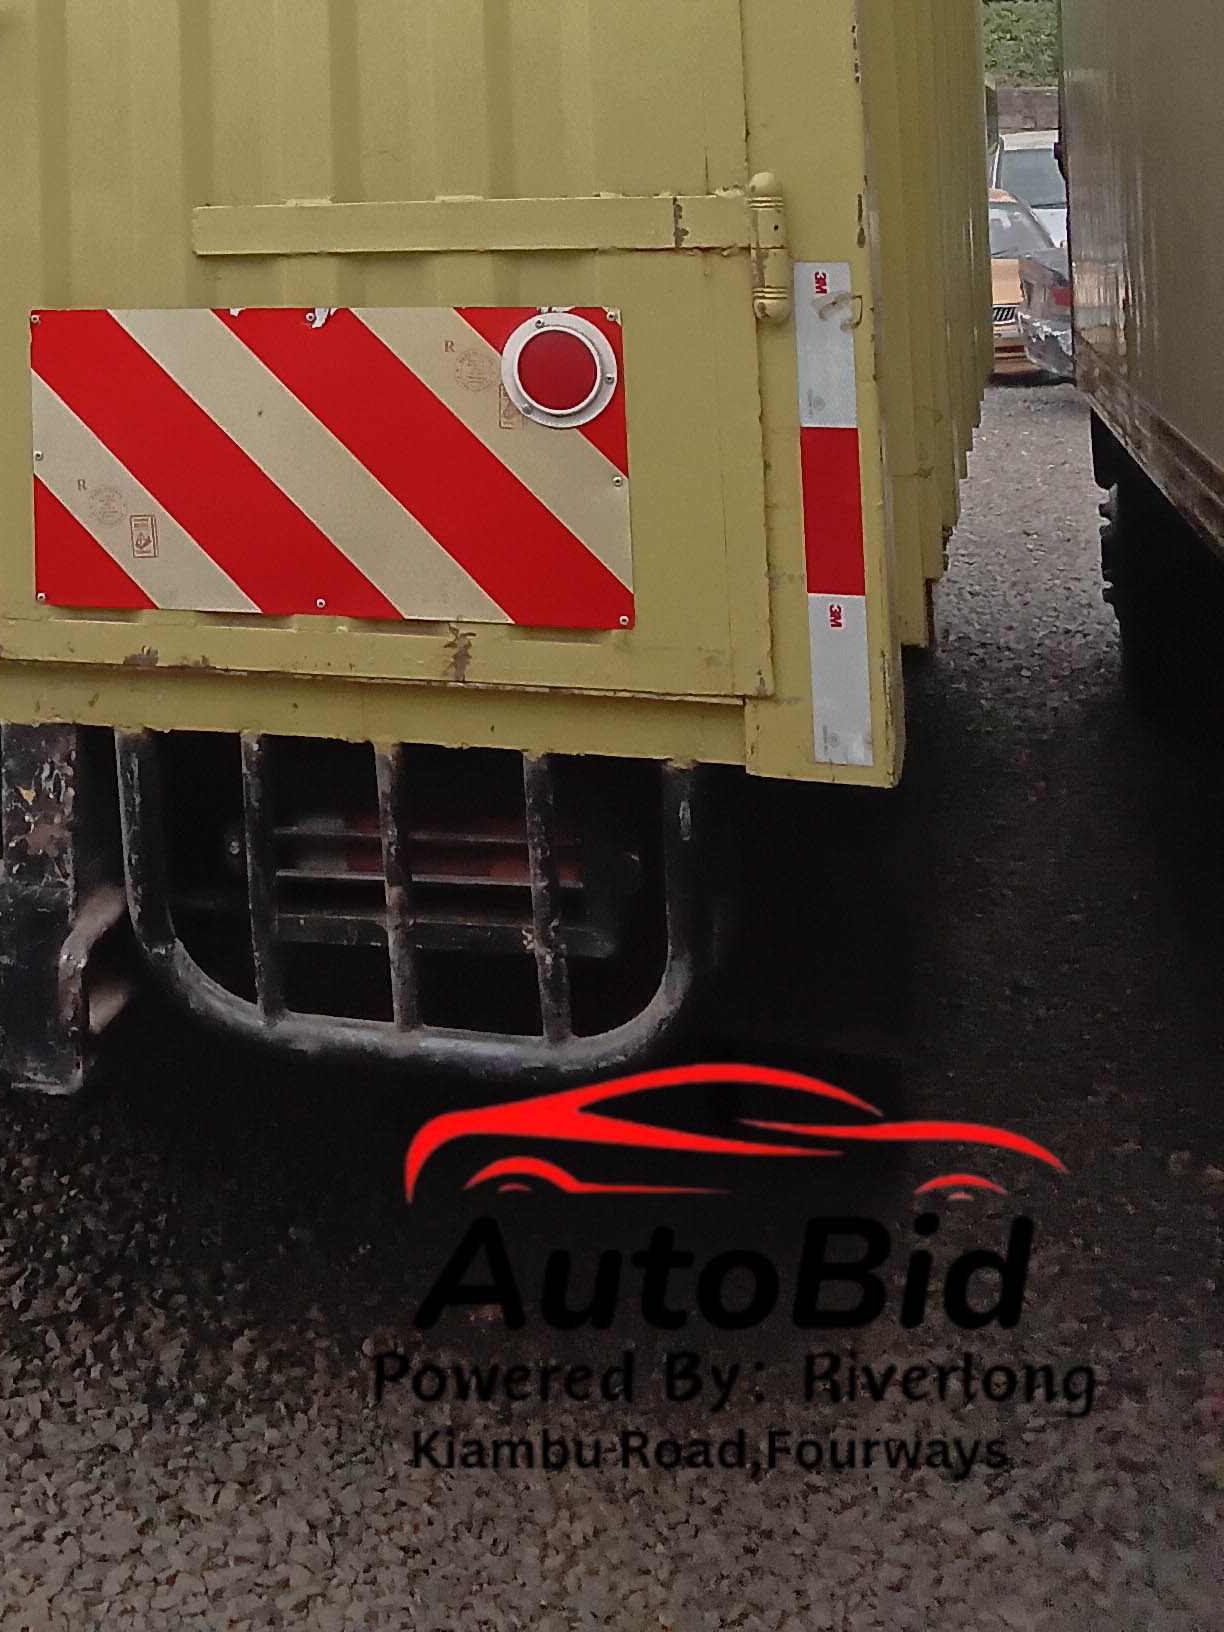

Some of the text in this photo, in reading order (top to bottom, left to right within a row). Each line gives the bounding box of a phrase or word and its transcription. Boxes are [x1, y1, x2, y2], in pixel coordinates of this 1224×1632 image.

[814, 271, 827, 295] 3M
[444, 340, 456, 353] R
[77, 479, 87, 492] R
[829, 604, 843, 628] 3M
